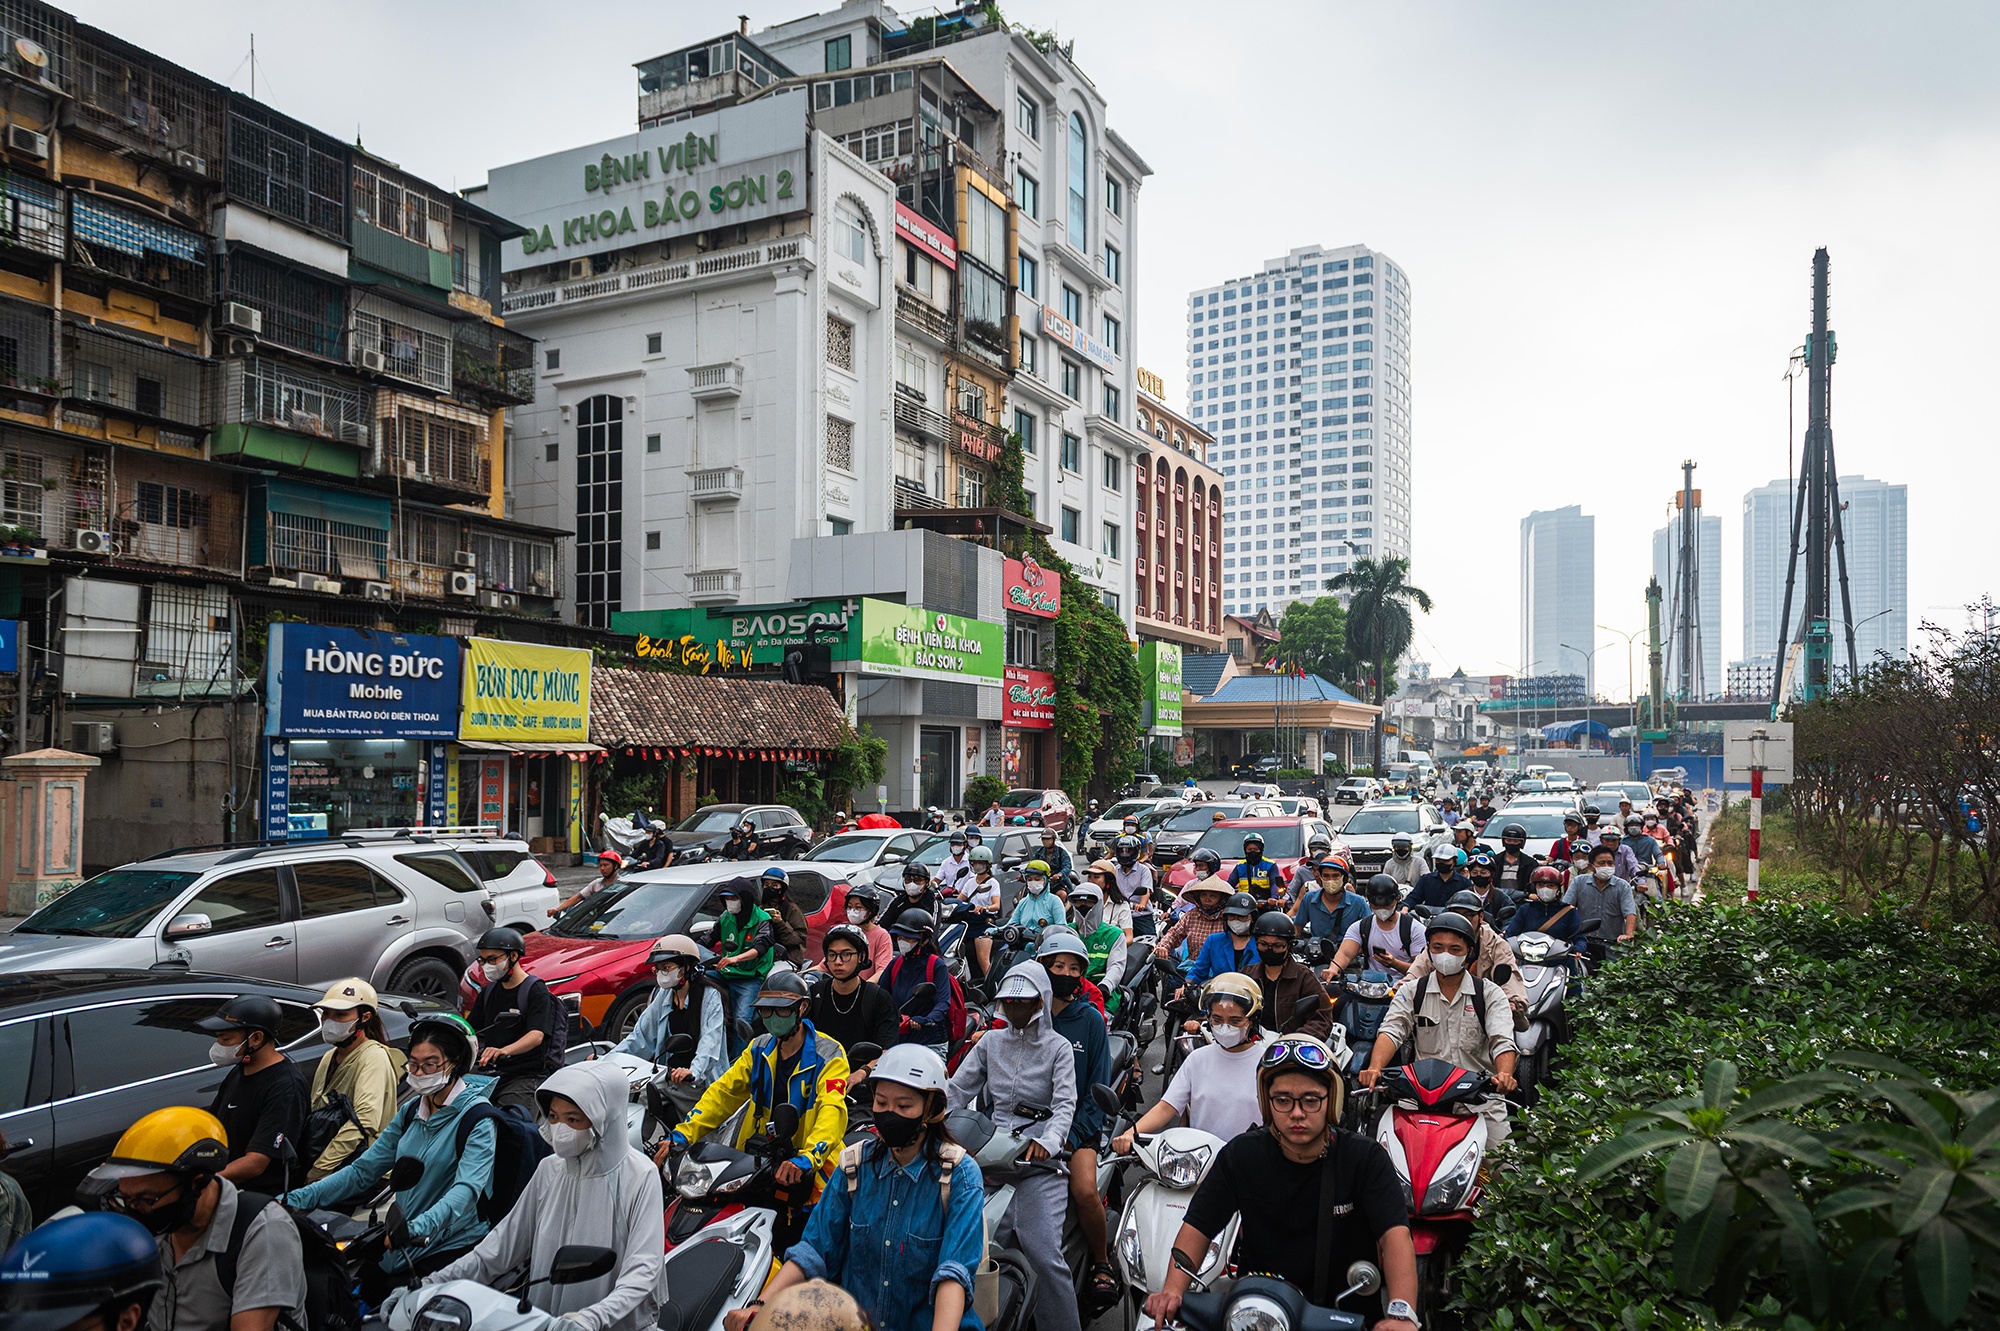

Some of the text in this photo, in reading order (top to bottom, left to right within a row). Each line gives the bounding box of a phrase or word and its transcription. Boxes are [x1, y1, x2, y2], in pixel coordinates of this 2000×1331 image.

[584, 131, 718, 195] BỆNH VIỆN
[521, 169, 794, 255] ĐA KHOA BẢO SƠN 2
[1046, 314, 1072, 342] JCB
[1088, 340, 1102, 360] NAM
[1137, 367, 1166, 401] OTEL
[1031, 591, 1057, 612] Xanh
[635, 632, 673, 659] Bánh
[783, 637, 803, 645] Khoa
[822, 635, 839, 643] Sơn
[895, 624, 982, 654] BỆNH VIỆN ĐA KHOA
[305, 640, 443, 679] HỒNG ĐỨC
[915, 647, 963, 671] BẢO SƠN 2
[476, 661, 580, 706] BÚN DỌC MÙNG
[1005, 669, 1029, 682] Nhà Hàng
[1159, 669, 1170, 683] BỆNH
[350, 683, 403, 700] Mobile
[1009, 684, 1057, 707] Biển Xanh
[1159, 690, 1180, 702] ĐA KHOA
[303, 708, 325, 718] MUA
[326, 707, 346, 719] BÁN
[347, 710, 372, 720] TRAO
[413, 712, 440, 722] THOẠI
[470, 710, 488, 725] SƯỜN
[489, 712, 502, 729] THỊT
[503, 713, 517, 729] MỌC
[542, 714, 558, 729] NƯỚC
[559, 717, 570, 729] HOA
[571, 714, 582, 730] QUẢ
[1158, 705, 1168, 720] BẢO
[1168, 708, 1178, 721] SƠN
[272, 776, 285, 785] CẤP
[271, 803, 286, 811] KIỆN
[270, 816, 286, 824] ĐIỆN
[269, 829, 287, 837] THOẠI
[1257, 868, 1267, 877] be
[1093, 942, 1107, 950] Grab
